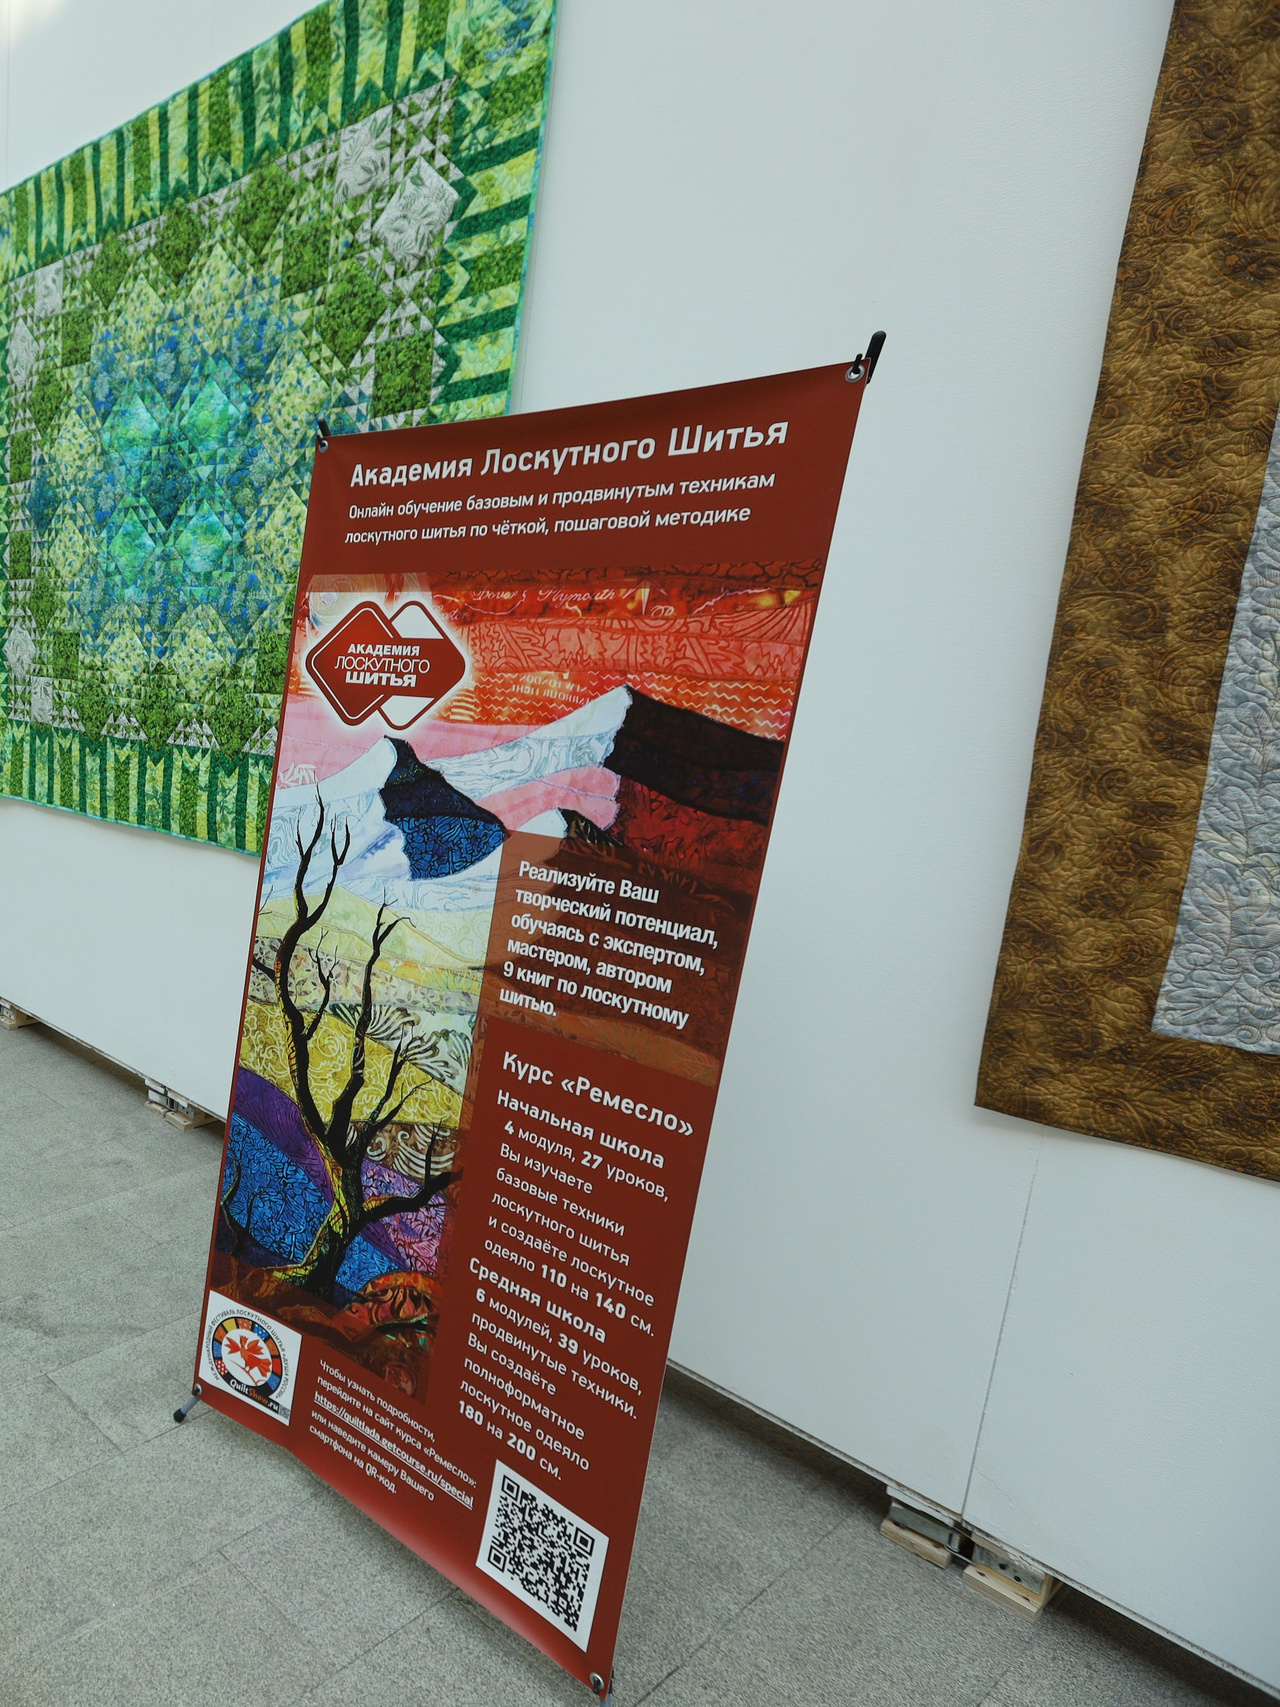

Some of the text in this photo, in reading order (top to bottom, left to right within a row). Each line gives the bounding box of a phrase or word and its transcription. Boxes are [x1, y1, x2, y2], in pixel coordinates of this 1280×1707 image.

[350, 422, 788, 487] Академия Лоскутного Шитья
[345, 508, 751, 545] лоскутного шитья по чёткой, пошаговой методике
[349, 474, 775, 519] Онлайн обучение базовым и продвинутым техникам
[536, 588, 617, 608] Plymouth
[334, 655, 430, 673] ЛОСКУТНОГО
[345, 670, 417, 687] ШИТЬЯ
[347, 643, 420, 657] АКАДЕМИЯ
[519, 861, 659, 903] Реализуйте Ваш
[511, 913, 704, 976] обучаясь с экспертом,
[516, 889, 718, 949] творческий потенциал,
[503, 961, 689, 1030] 9 книг по лоскутному
[507, 939, 672, 993] мастером, автором
[500, 988, 557, 1016] шитью.
[503, 1051, 693, 1136] Курс «Ремесло»
[497, 1090, 664, 1168] Начальная школа
[504, 1120, 668, 1202] 4 модуля, 27 уроков,
[497, 1168, 624, 1236] базовые техники
[500, 1143, 592, 1193] Вы изучаете
[489, 1216, 654, 1306] и создаёте лоскутное
[492, 1193, 629, 1266] лоскутного шитья
[211, 1309, 235, 1327] ФЕСТИВАЛЬ
[236, 1309, 272, 1330] ЛОСКУТНОГО
[470, 1258, 605, 1343] Средняя школа
[485, 1240, 654, 1337] одеяло 110 на 140 см.
[468, 1332, 556, 1395] Вы создаёте
[472, 1313, 636, 1419] продвинутые техники.
[476, 1288, 641, 1396] 6 модулей, 39 уроков,
[230, 1380, 279, 1412] QuiltShow.ru
[320, 1359, 435, 1443] Чтобы узнать подробности,
[460, 1380, 589, 1470] лоскутное одеяло
[464, 1358, 584, 1440] полноформатное
[310, 1425, 396, 1493] смартфона на QR-код.
[312, 1411, 434, 1501] или наведите камеру Вашего
[314, 1391, 473, 1510] https://quiltlada.getcourse.ru/special
[317, 1376, 476, 1488] перейдите на сайт курса «Ремесло»:
[459, 1400, 561, 1480] 180 на 200 см.
